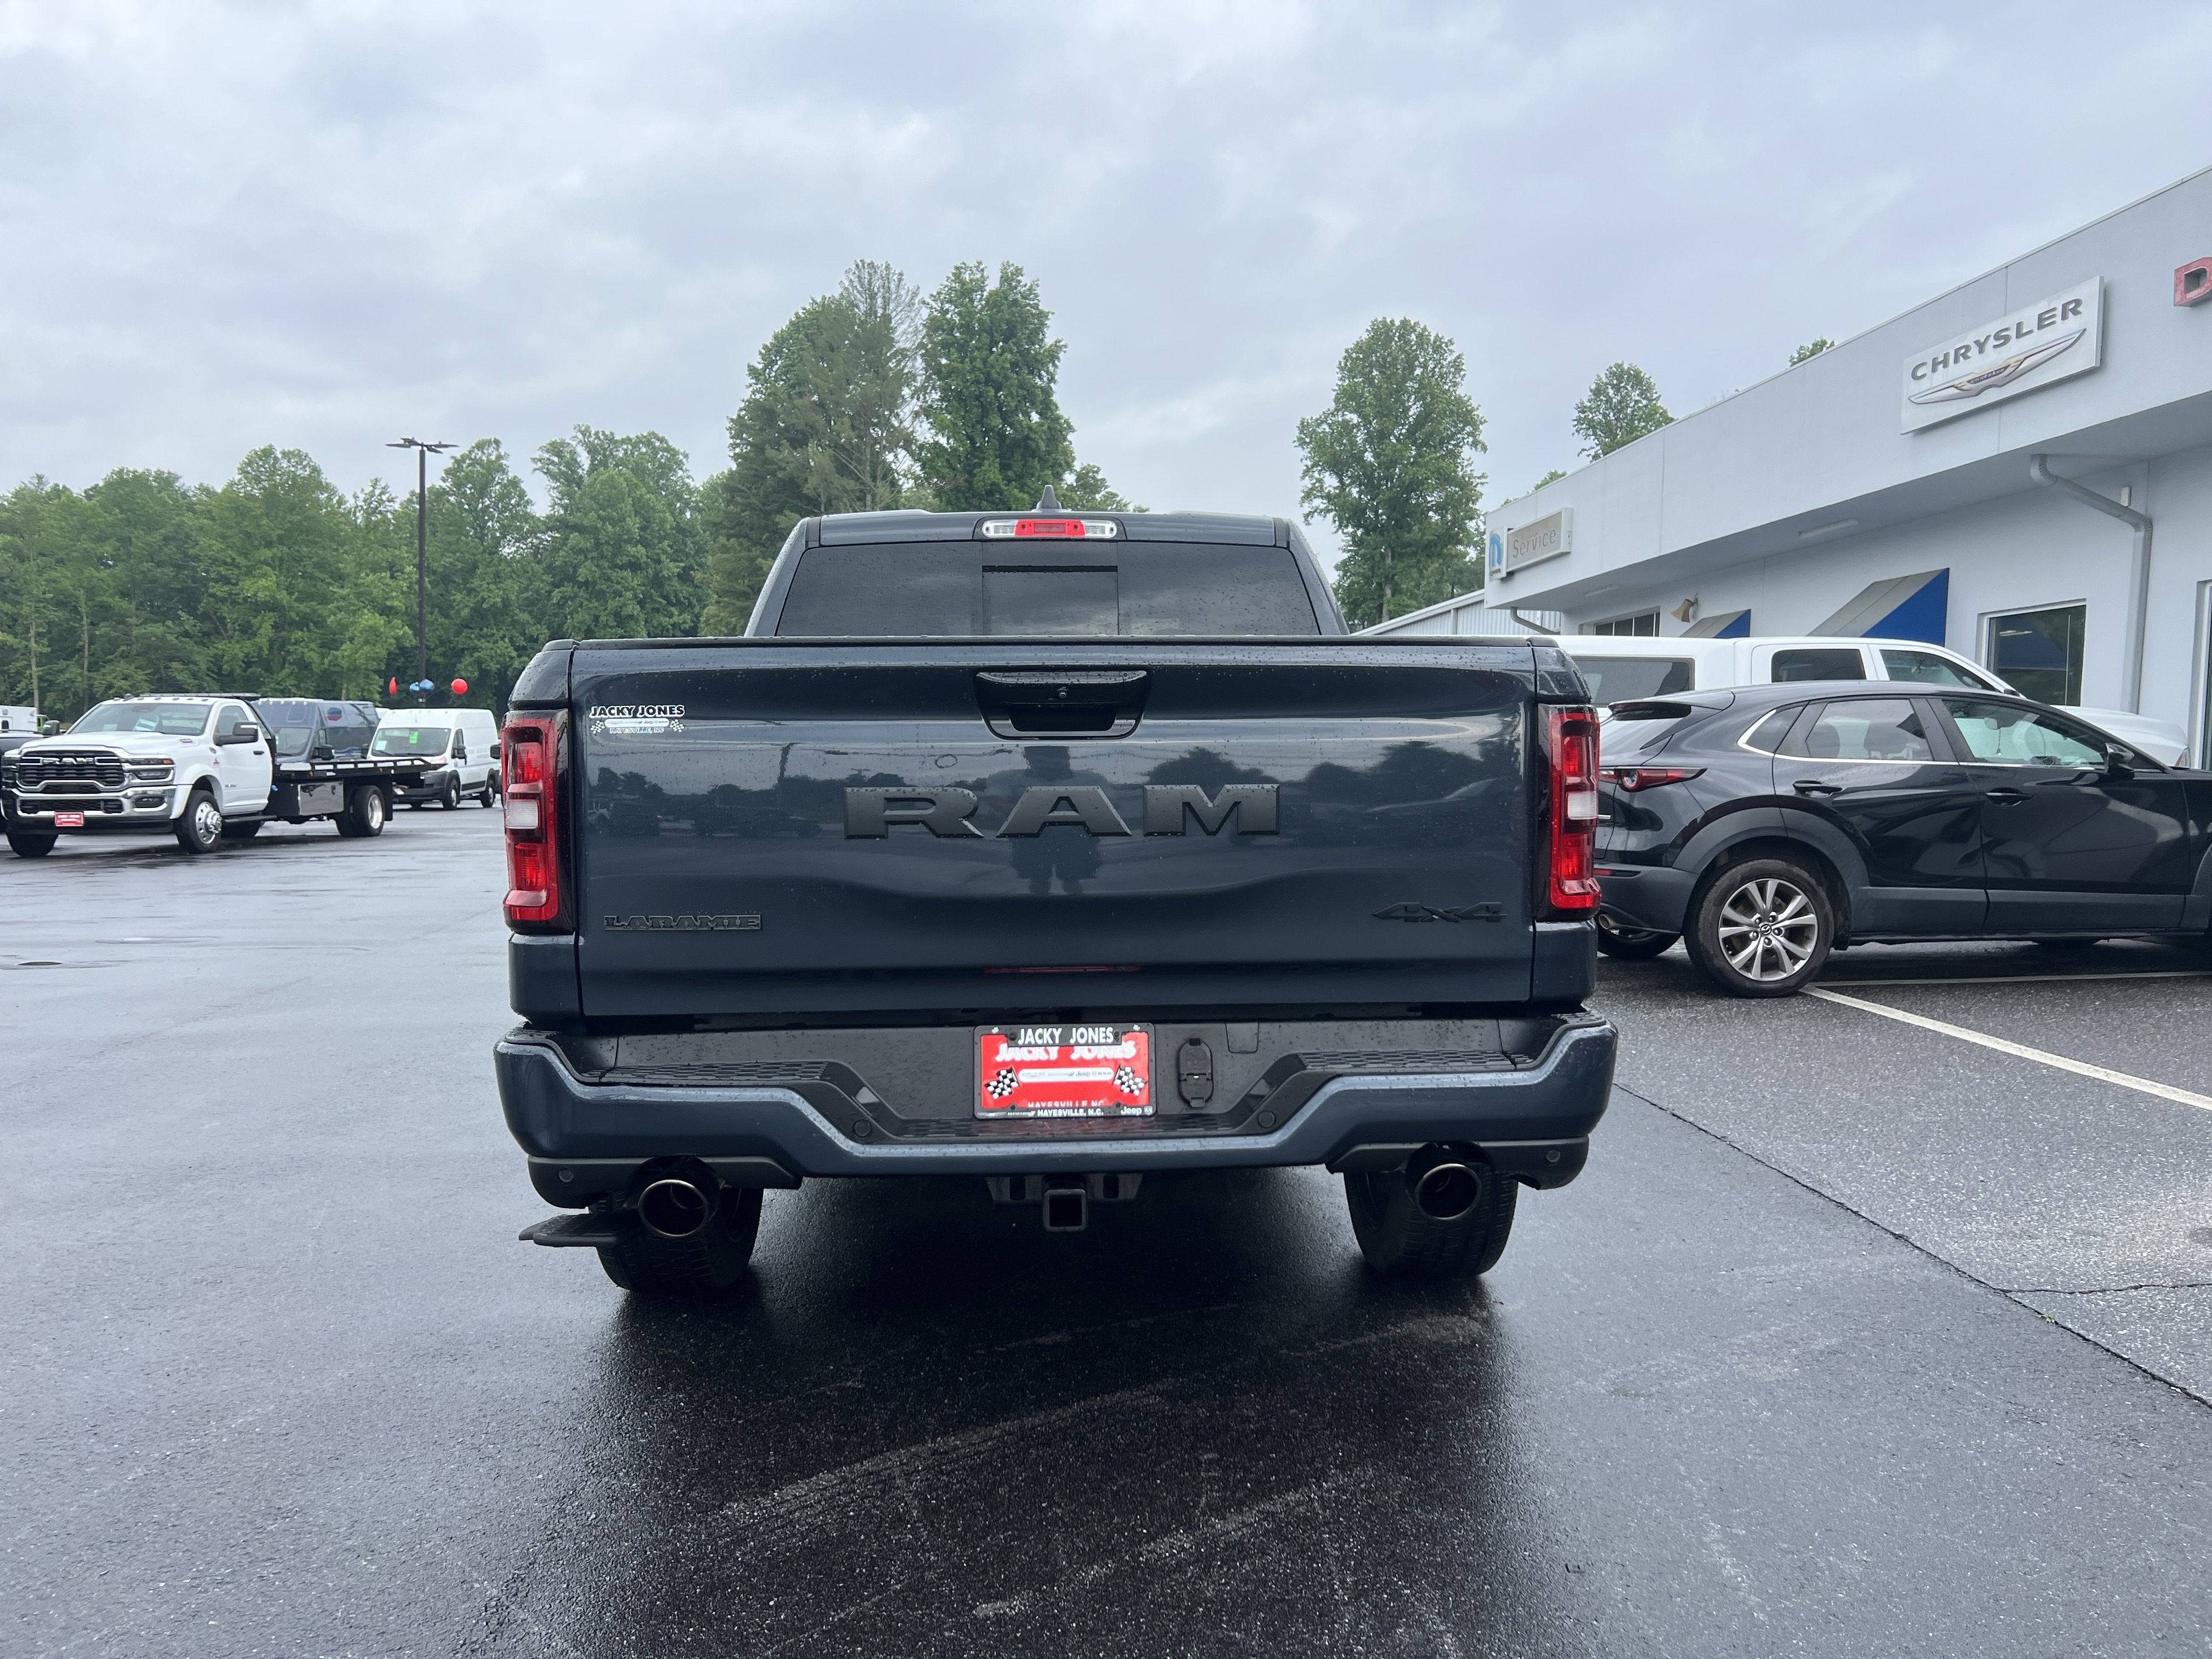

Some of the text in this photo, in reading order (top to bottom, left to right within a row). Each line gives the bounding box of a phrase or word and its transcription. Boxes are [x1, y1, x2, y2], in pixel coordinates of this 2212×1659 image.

[1911, 298, 2083, 380] CHRYSLER
[1513, 529, 1556, 558] Service
[589, 704, 685, 718] JACKY JONES
[844, 785, 1280, 839] RAM
[603, 915, 763, 931] LARAMIE
[1018, 1026, 1113, 1045] JACKY JONES
[995, 1040, 1137, 1062] JACKY JONES
[1037, 1108, 1087, 1117] HAYESVILLE,
[1088, 1108, 1104, 1116] N.C.
[1120, 1106, 1142, 1116] Jeep
